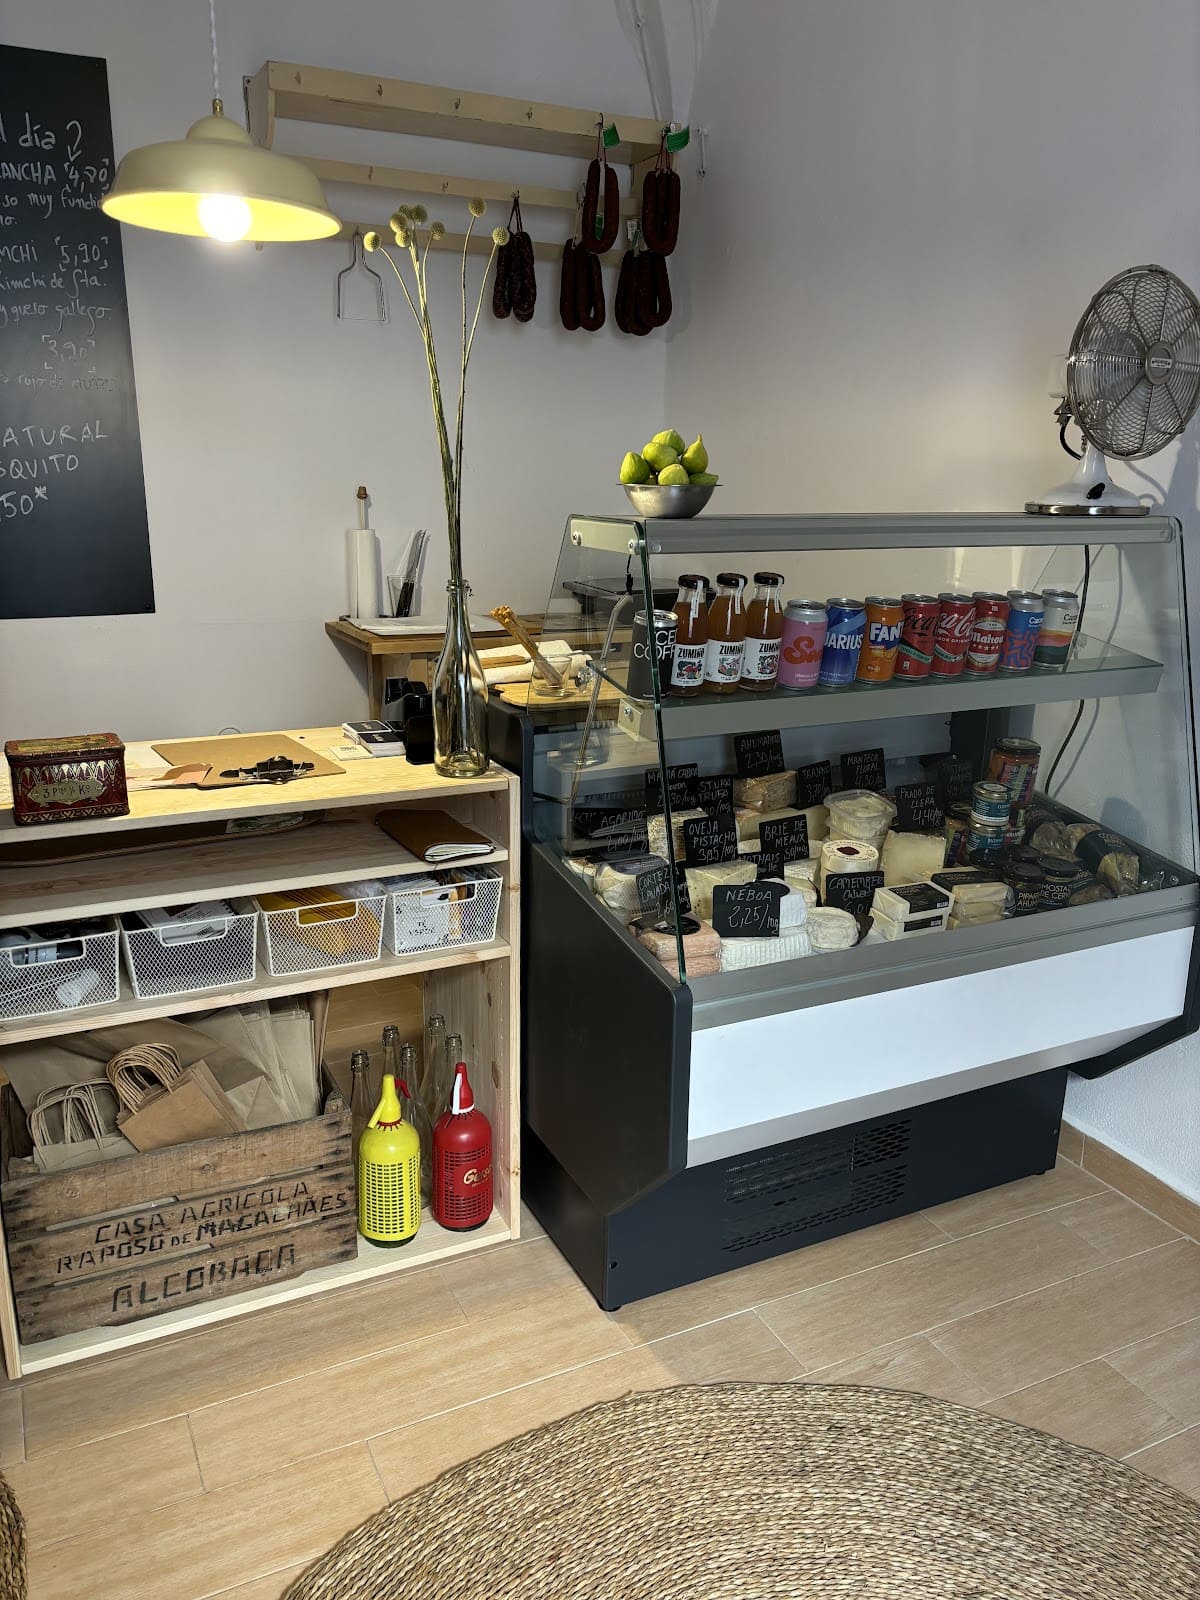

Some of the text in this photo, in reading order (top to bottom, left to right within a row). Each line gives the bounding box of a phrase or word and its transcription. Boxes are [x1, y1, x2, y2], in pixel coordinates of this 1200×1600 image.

[18, 111, 56, 150] día
[0, 161, 57, 185] ANCHA
[27, 193, 53, 220] muy
[60, 185, 100, 210] fundi
[50, 273, 65, 289] de
[869, 621, 904, 642] FAN
[688, 820, 719, 836] OVEJA
[764, 819, 807, 841] BRIE DE
[693, 831, 736, 849] PISTACHO
[726, 889, 772, 902] NEBOA
[95, 1181, 309, 1244] CASA AGRICOLA
[56, 1233, 165, 1274] RAPOSO
[171, 1232, 192, 1247] DE
